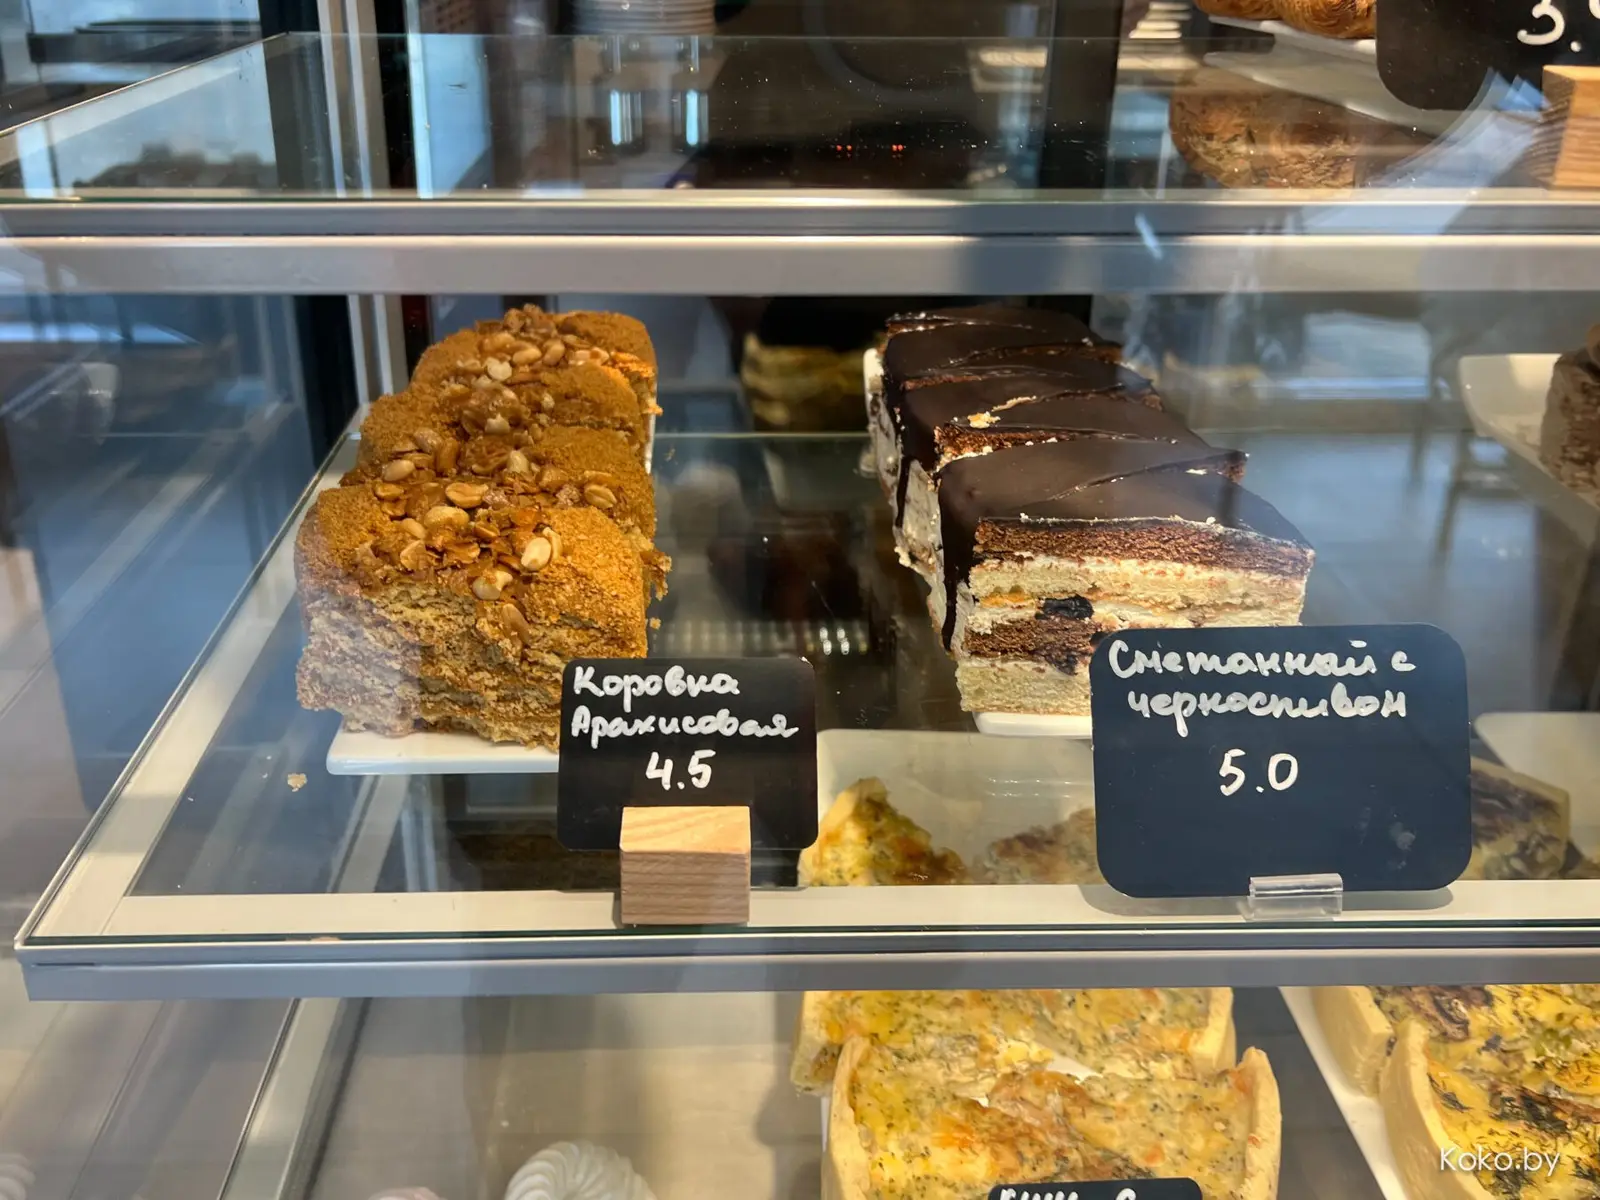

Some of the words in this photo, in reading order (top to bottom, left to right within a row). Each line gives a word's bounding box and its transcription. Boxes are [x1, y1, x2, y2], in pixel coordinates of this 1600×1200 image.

[1516, 0, 1600, 53] 3.
[573, 665, 741, 713] Коровка
[571, 705, 800, 749] Арахисовая
[645, 748, 717, 790] 4.5
[1218, 748, 1299, 797] 5.0
